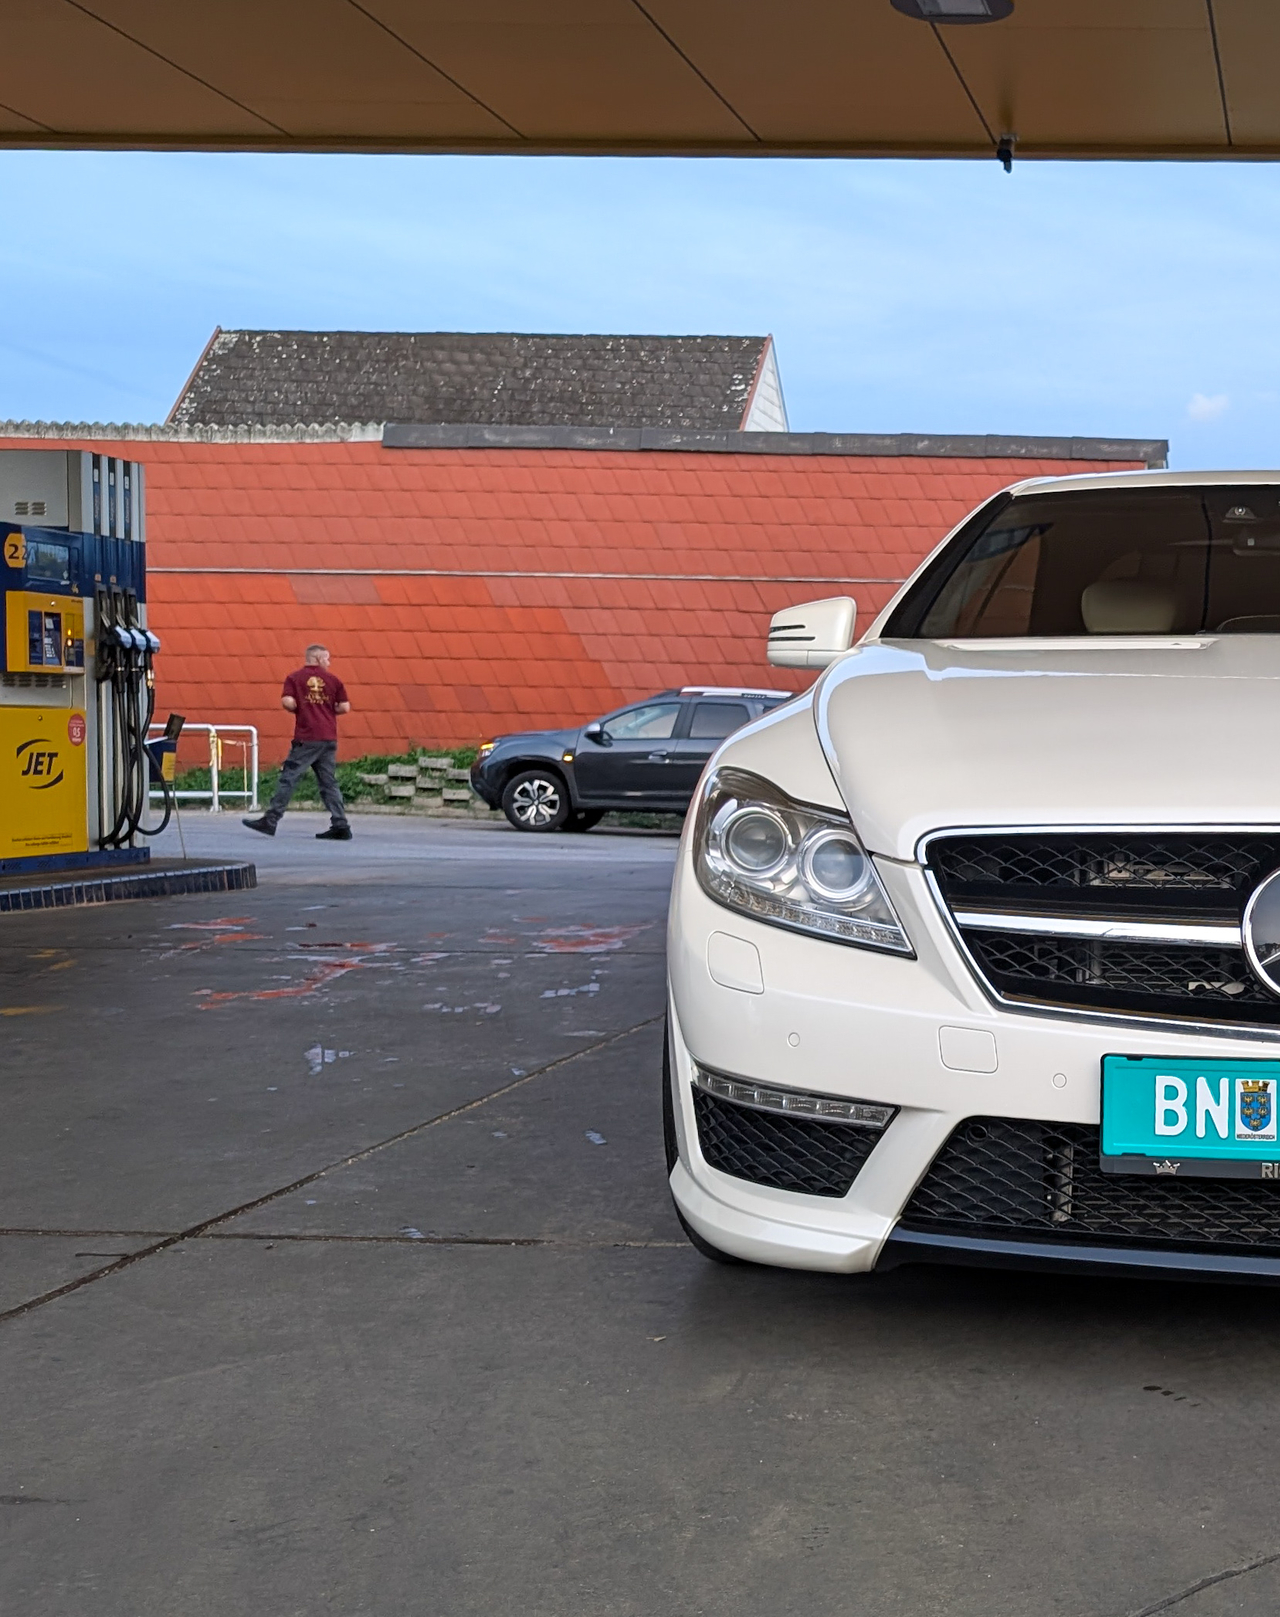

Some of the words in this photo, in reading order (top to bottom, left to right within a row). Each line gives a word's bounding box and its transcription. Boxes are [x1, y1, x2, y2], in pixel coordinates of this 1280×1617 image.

[8, 543, 20, 560] 2
[21, 752, 59, 776] JET
[1155, 1075, 1229, 1139] BN
